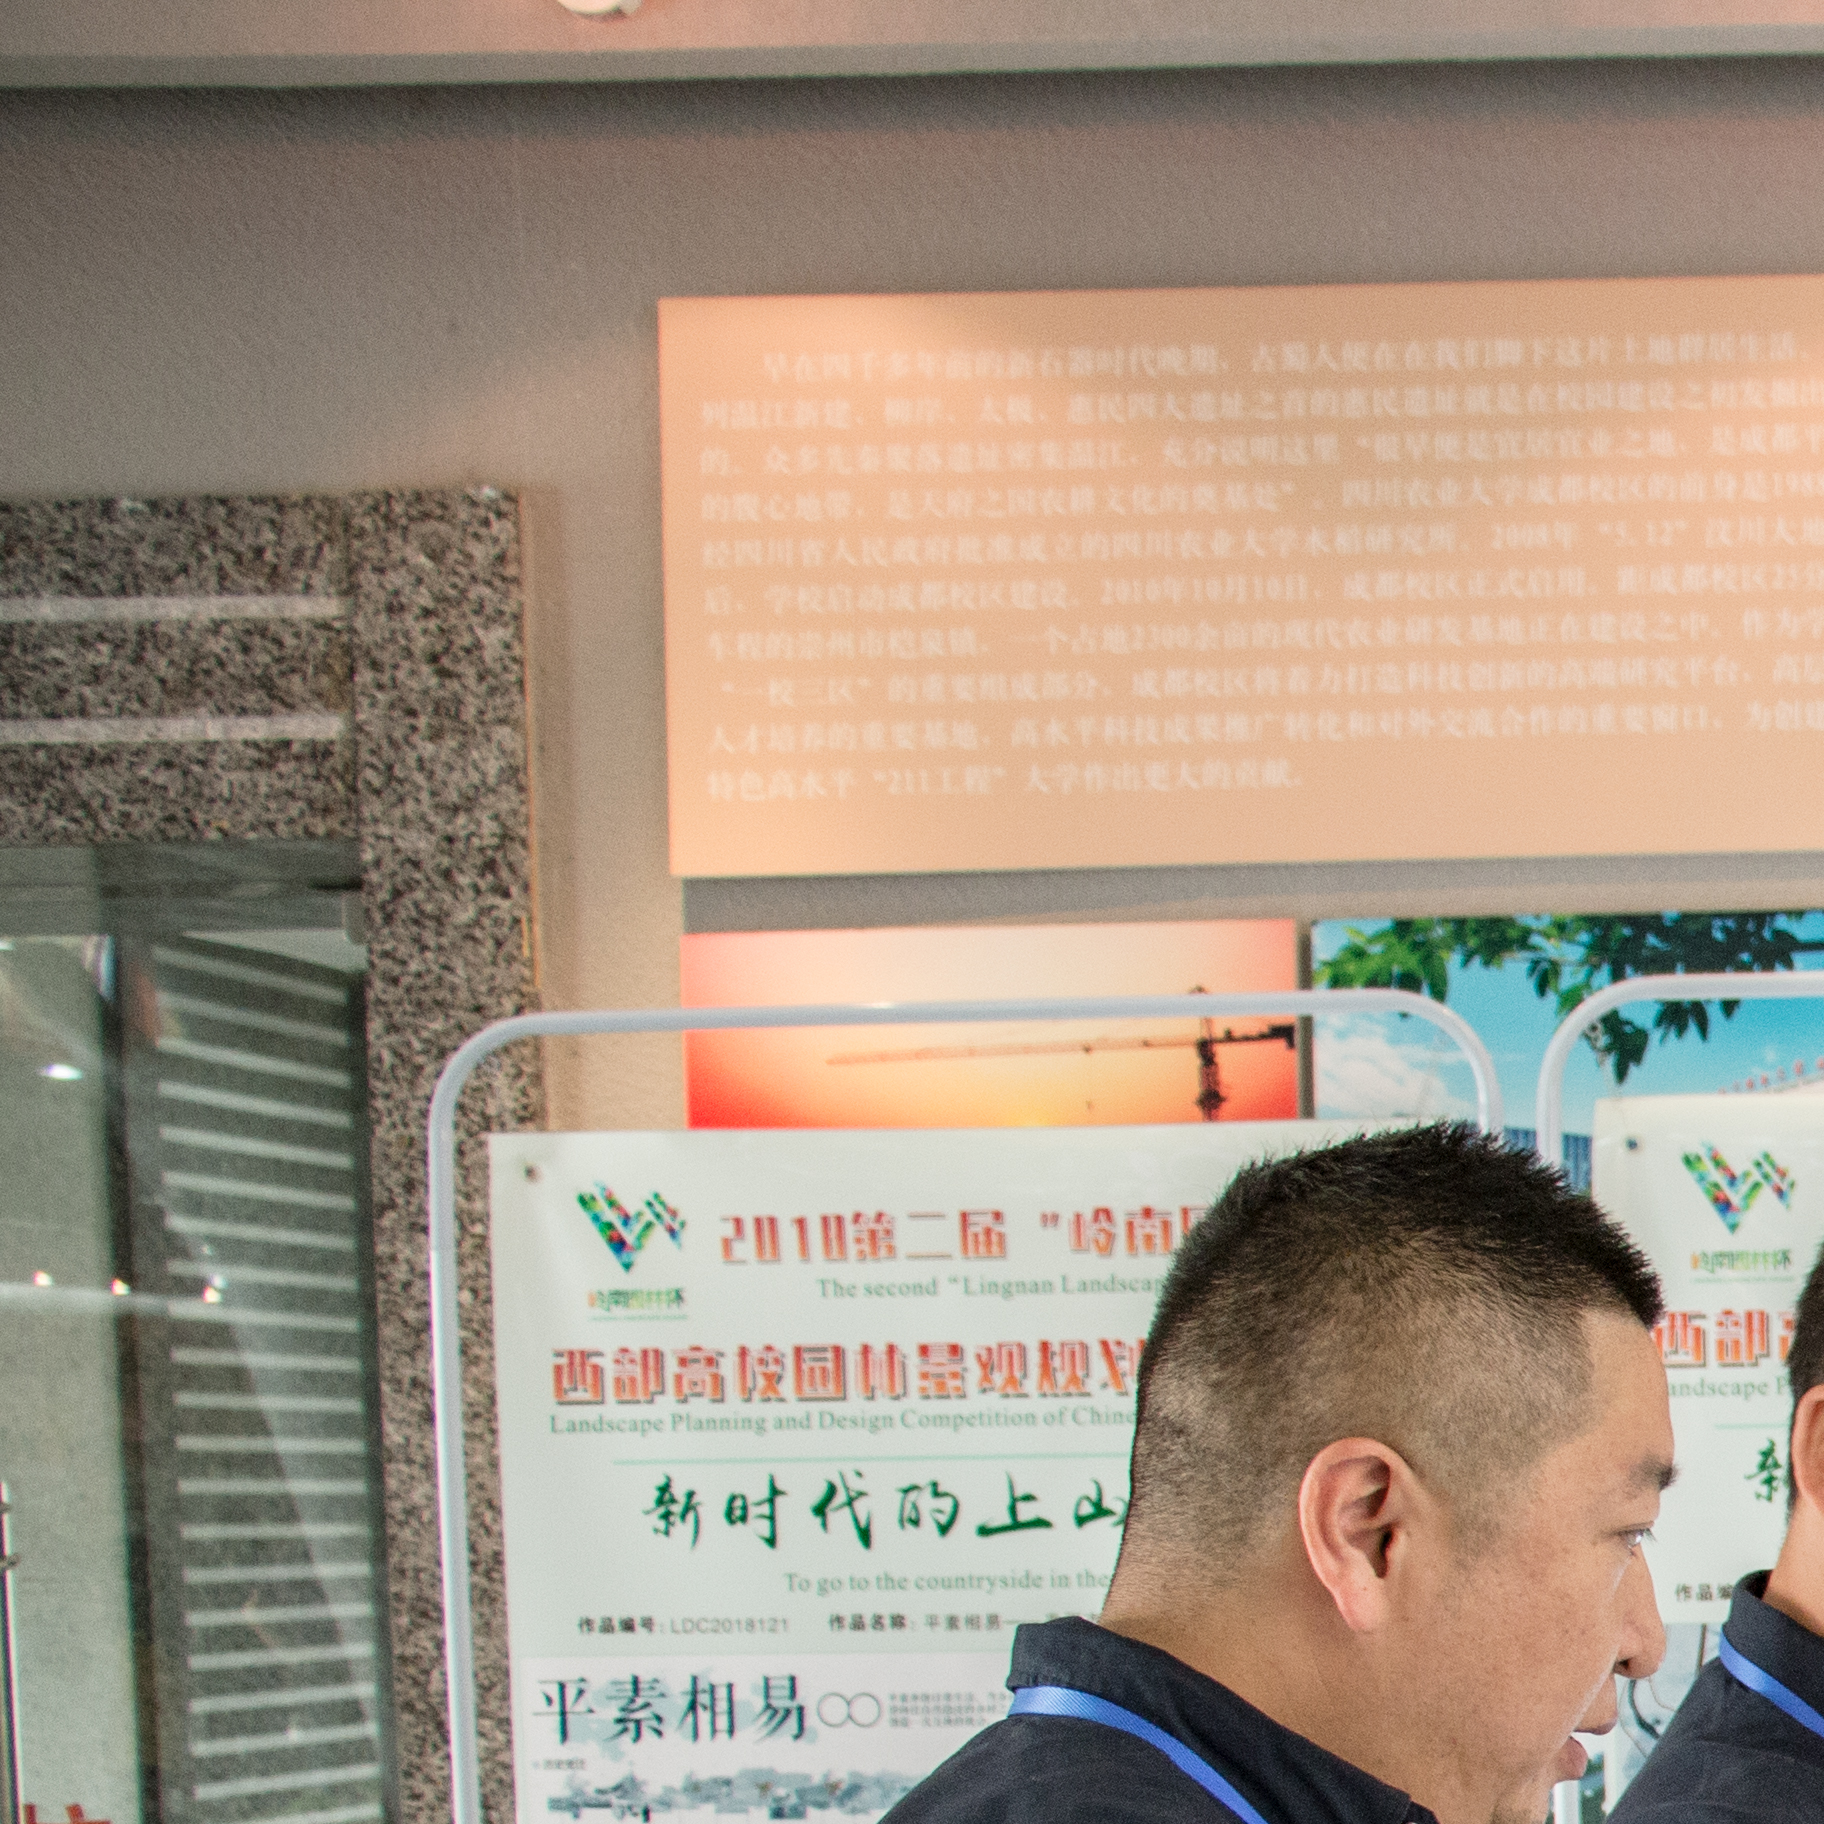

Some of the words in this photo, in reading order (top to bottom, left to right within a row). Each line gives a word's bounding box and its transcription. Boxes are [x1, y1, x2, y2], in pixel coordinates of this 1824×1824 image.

[817, 1277, 858, 1299] The
[862, 1276, 938, 1298] second
[1060, 1273, 1169, 1299] Landscap
[1669, 1376, 1771, 1402] andscape
[549, 1411, 664, 1438] Landscape
[670, 1410, 767, 1435] Planning
[773, 1410, 812, 1430] and
[818, 1409, 895, 1434] Design
[899, 1408, 1038, 1432] Competition
[1042, 1407, 1067, 1427] of
[1070, 1406, 1137, 1426] Chine
[785, 1572, 811, 1592] To
[816, 1578, 843, 1597] go
[848, 1574, 870, 1591] to
[875, 1571, 908, 1591] the
[913, 1569, 1043, 1593] countryside
[1049, 1571, 1072, 1589] in
[1075, 1569, 1113, 1589] the
[533, 1672, 808, 1746] 平素相易
